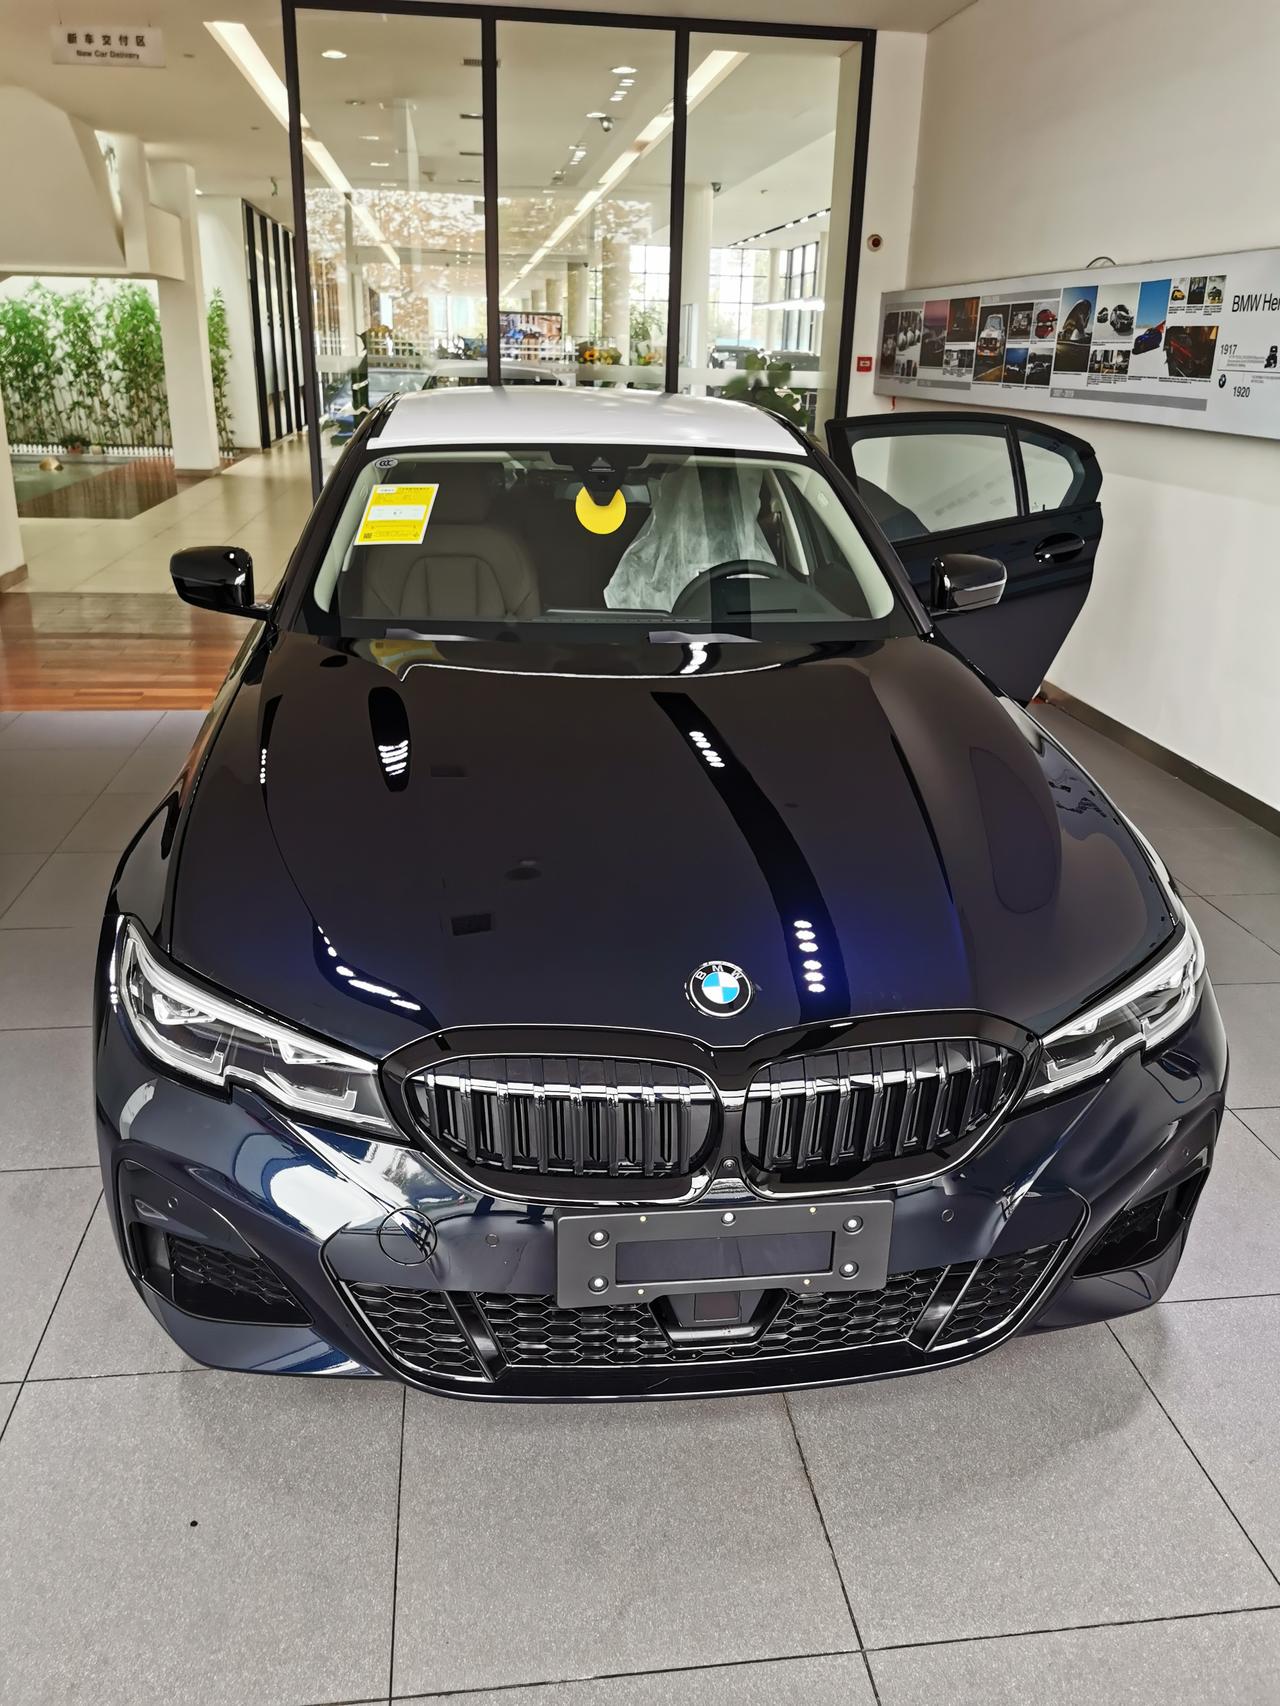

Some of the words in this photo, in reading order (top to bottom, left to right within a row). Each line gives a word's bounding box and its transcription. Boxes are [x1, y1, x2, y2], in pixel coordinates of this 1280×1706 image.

[67, 33, 146, 47] 新车交付区
[94, 50, 107, 58] Car
[109, 50, 139, 60] Delivery
[1232, 294, 1262, 312] BMW
[1220, 344, 1238, 355] 1917
[1233, 386, 1251, 398] 1920
[695, 964, 743, 980] BMW
